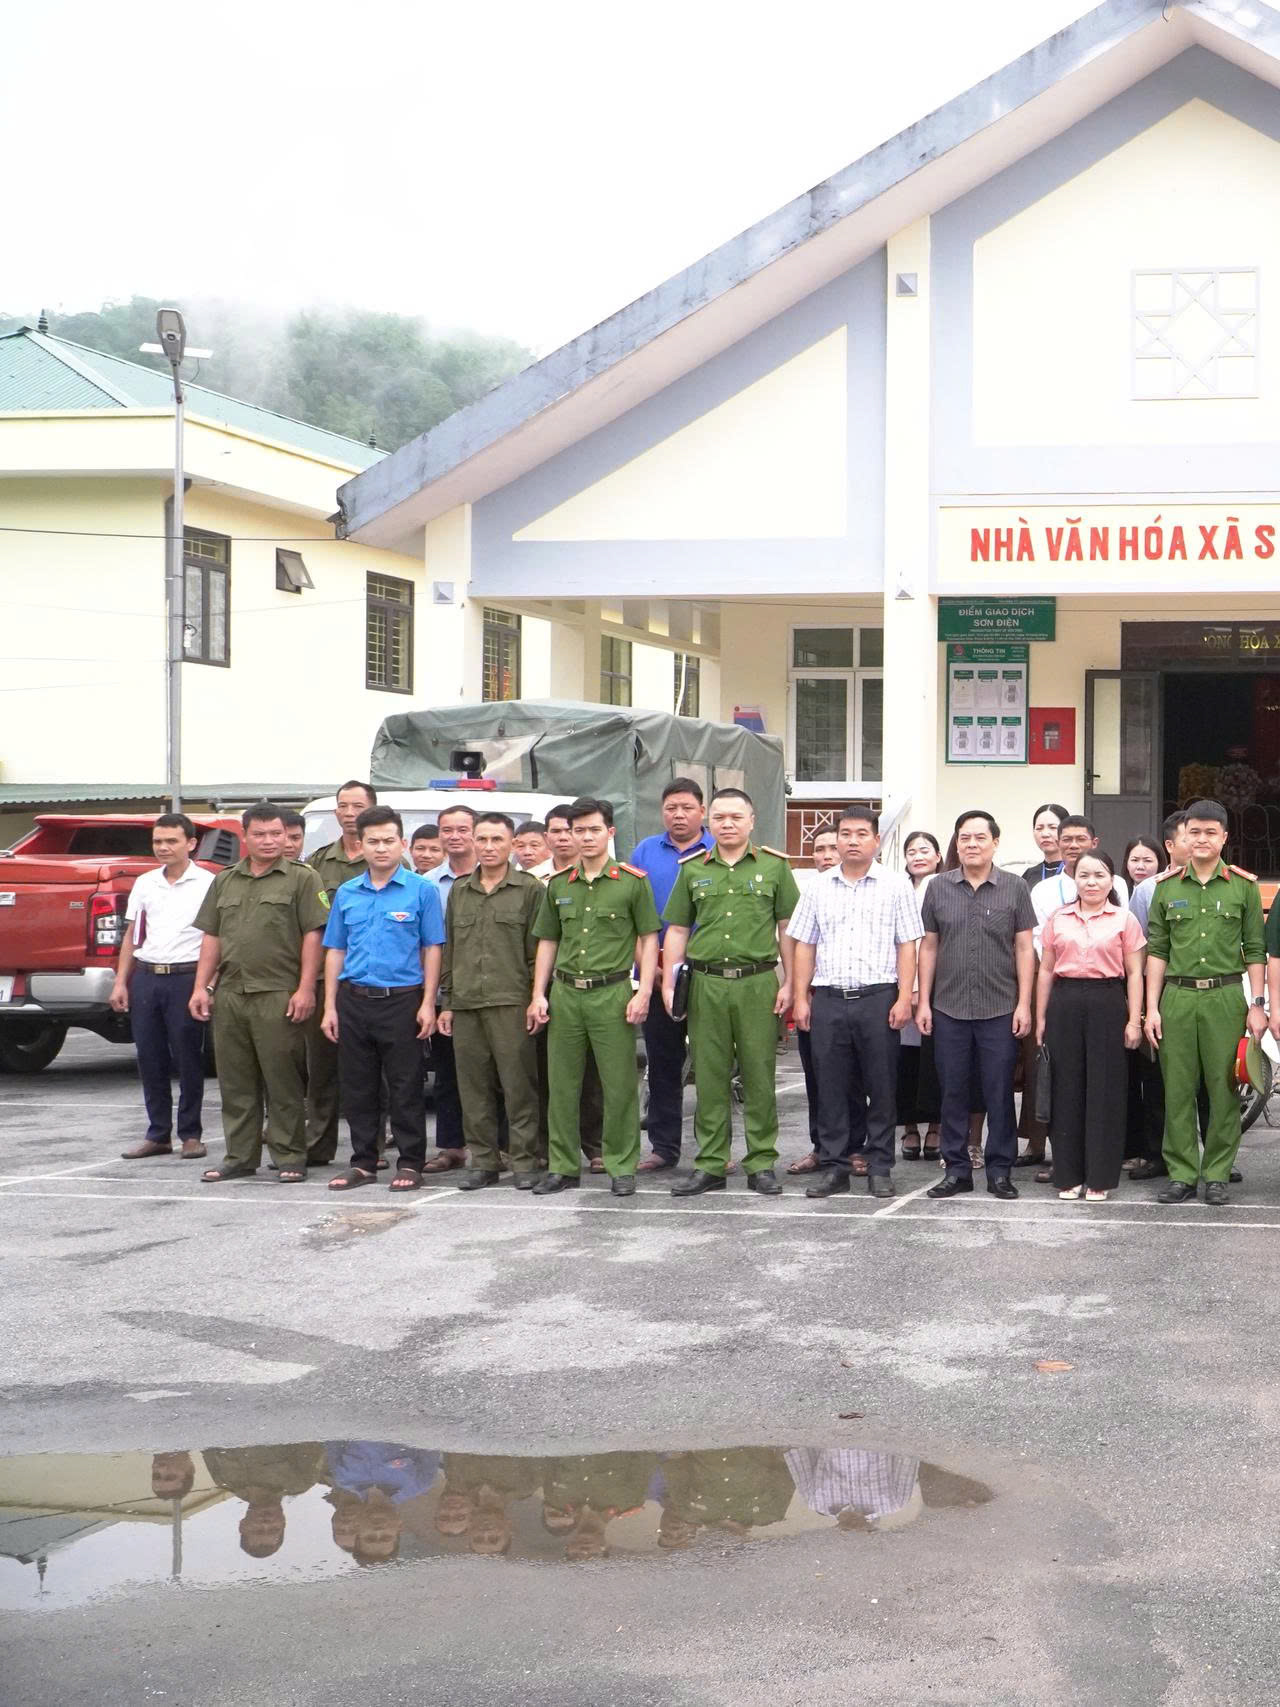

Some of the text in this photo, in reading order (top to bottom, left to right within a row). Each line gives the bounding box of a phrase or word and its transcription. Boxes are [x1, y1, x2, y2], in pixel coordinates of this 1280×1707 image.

[971, 517, 1035, 562] NHÀ
[1045, 517, 1109, 562] VĂN
[1119, 514, 1188, 561] HÓA
[1198, 516, 1243, 560] XÃ
[985, 607, 1008, 616] GIAO
[1239, 631, 1270, 650] HÒA
